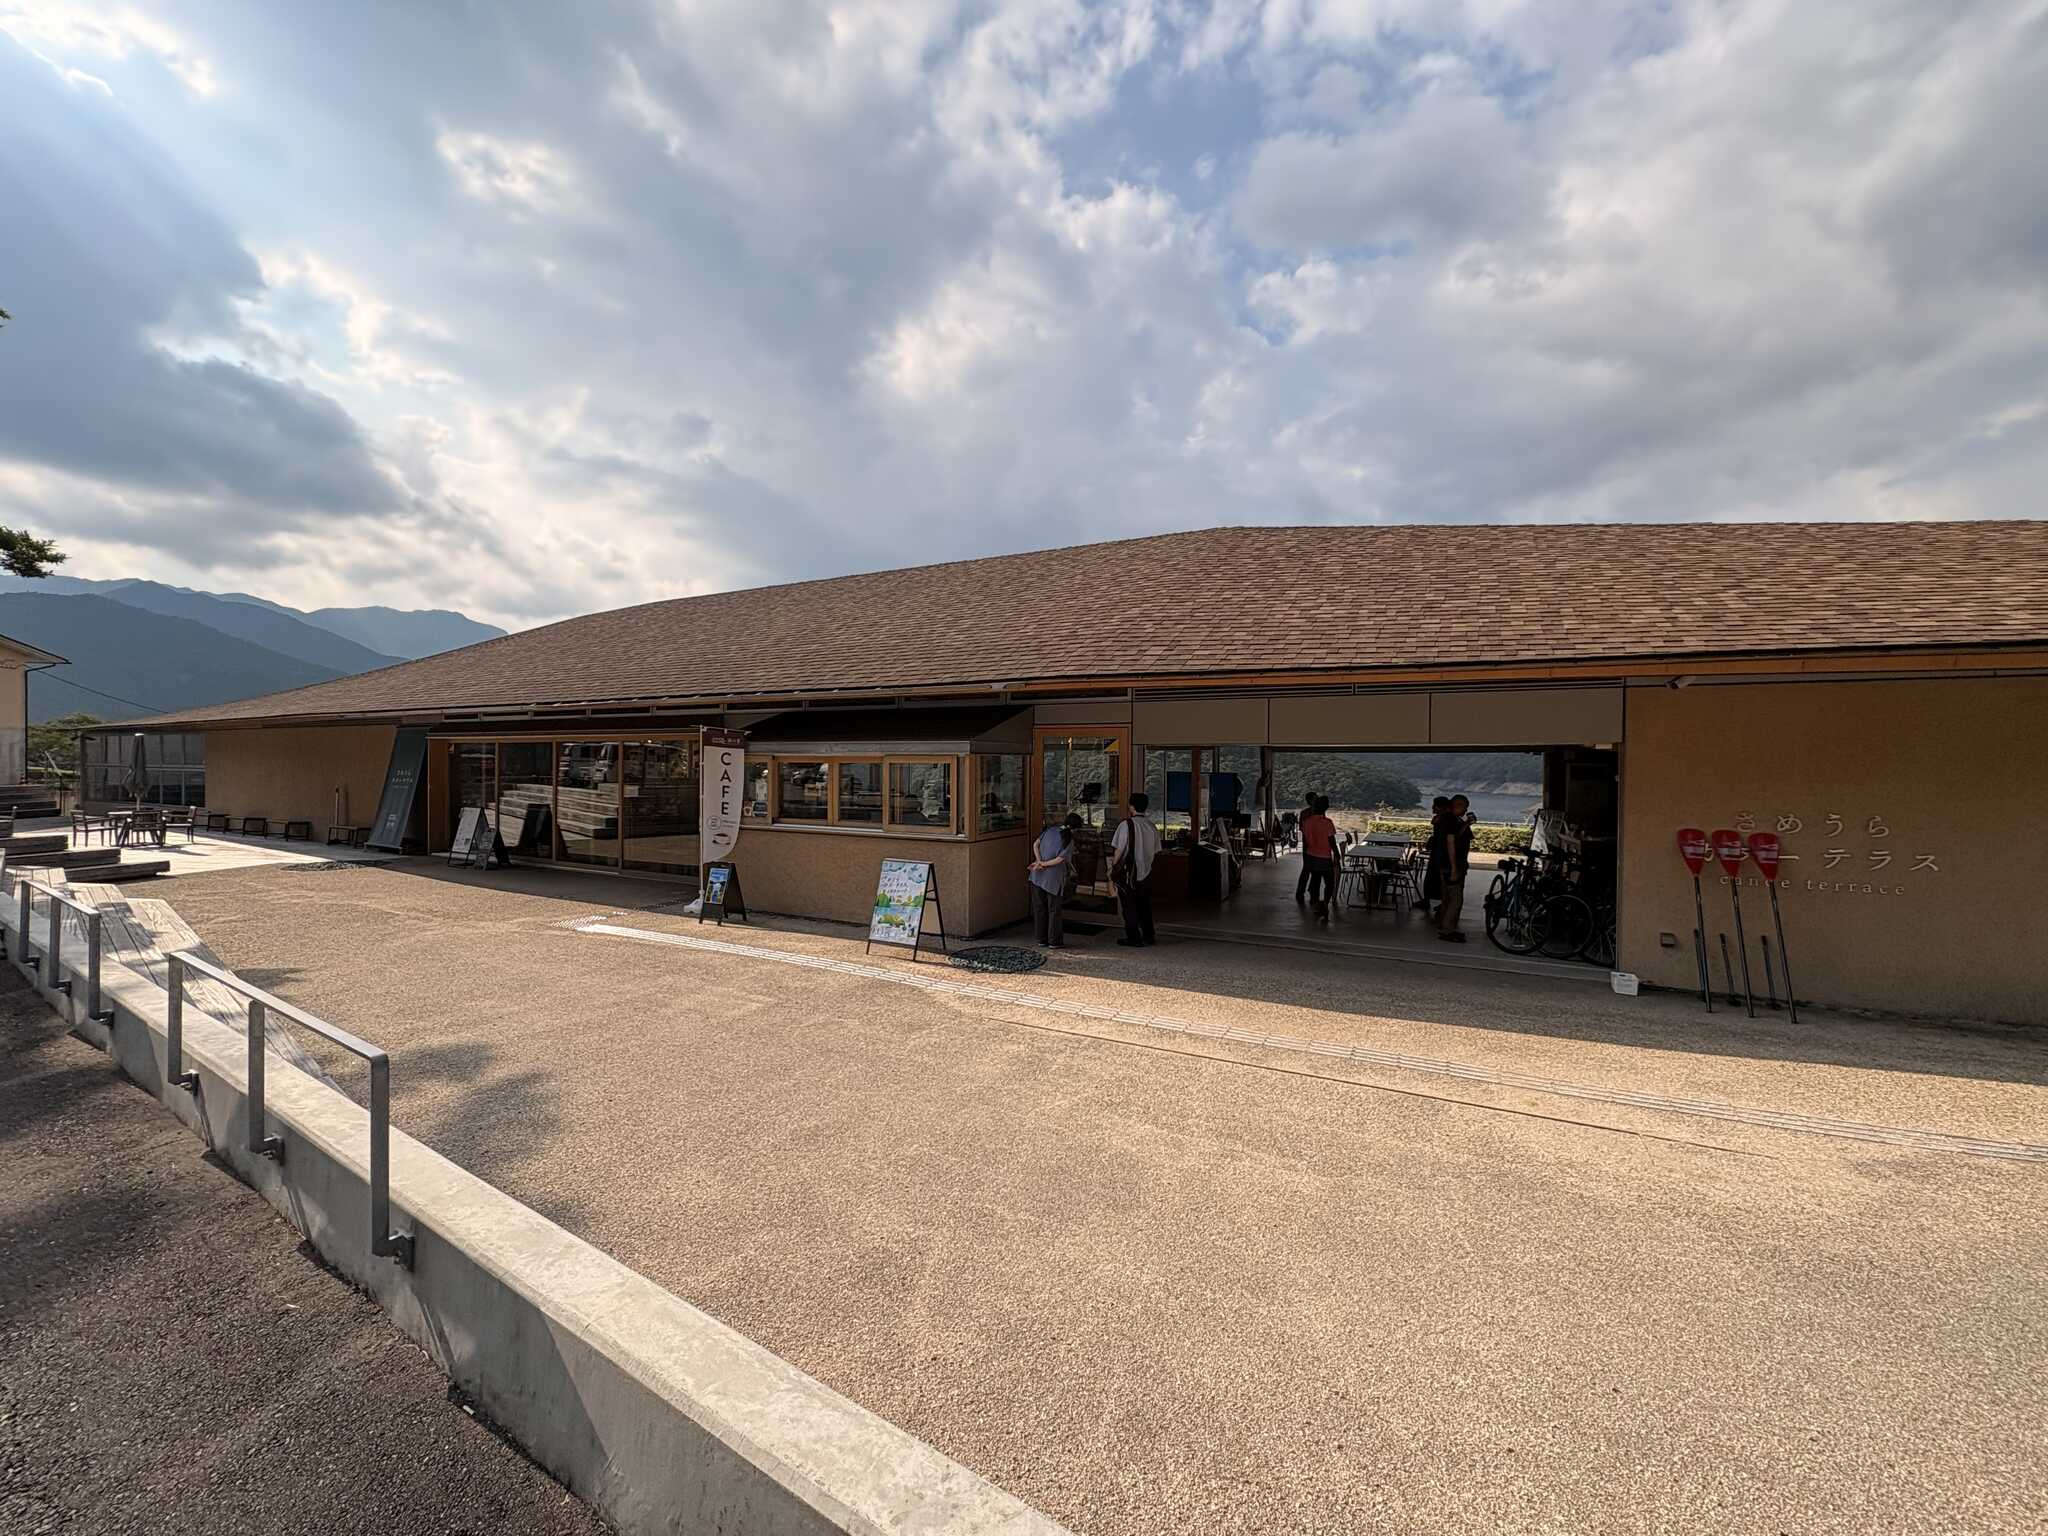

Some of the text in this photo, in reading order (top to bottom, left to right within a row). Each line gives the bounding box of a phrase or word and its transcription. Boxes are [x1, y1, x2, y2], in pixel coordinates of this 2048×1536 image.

[720, 752, 732, 816] CAFE
[1735, 812, 1890, 838] さめうら
[1806, 880, 1905, 896] terrace
